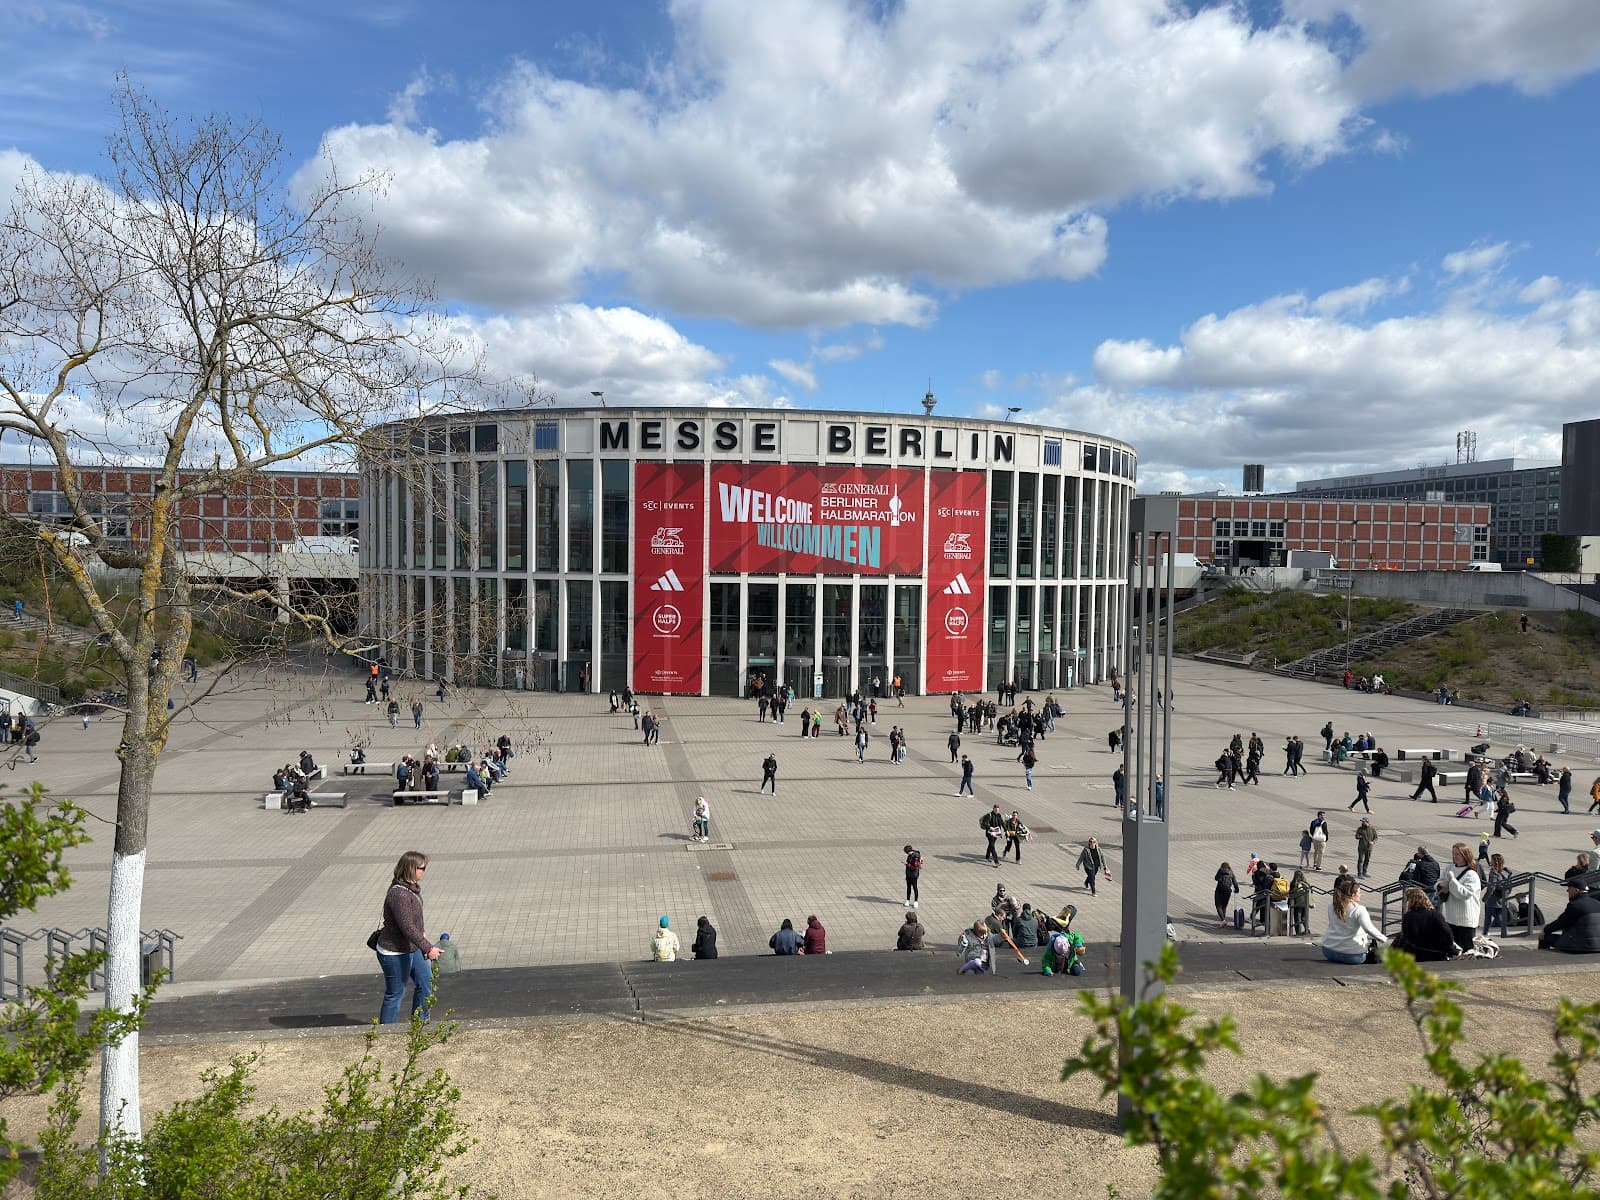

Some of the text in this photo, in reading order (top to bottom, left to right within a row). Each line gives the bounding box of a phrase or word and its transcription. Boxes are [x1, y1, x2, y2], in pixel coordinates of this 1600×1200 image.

[601, 422, 1013, 462] MESSE BERLIN
[838, 484, 889, 495] GENERALI
[643, 502, 658, 510] SCC
[719, 482, 812, 523] WELCOME
[821, 497, 878, 508] BERLINER
[651, 547, 684, 555] GENERALI
[757, 523, 880, 568] WILLKOMMEN
